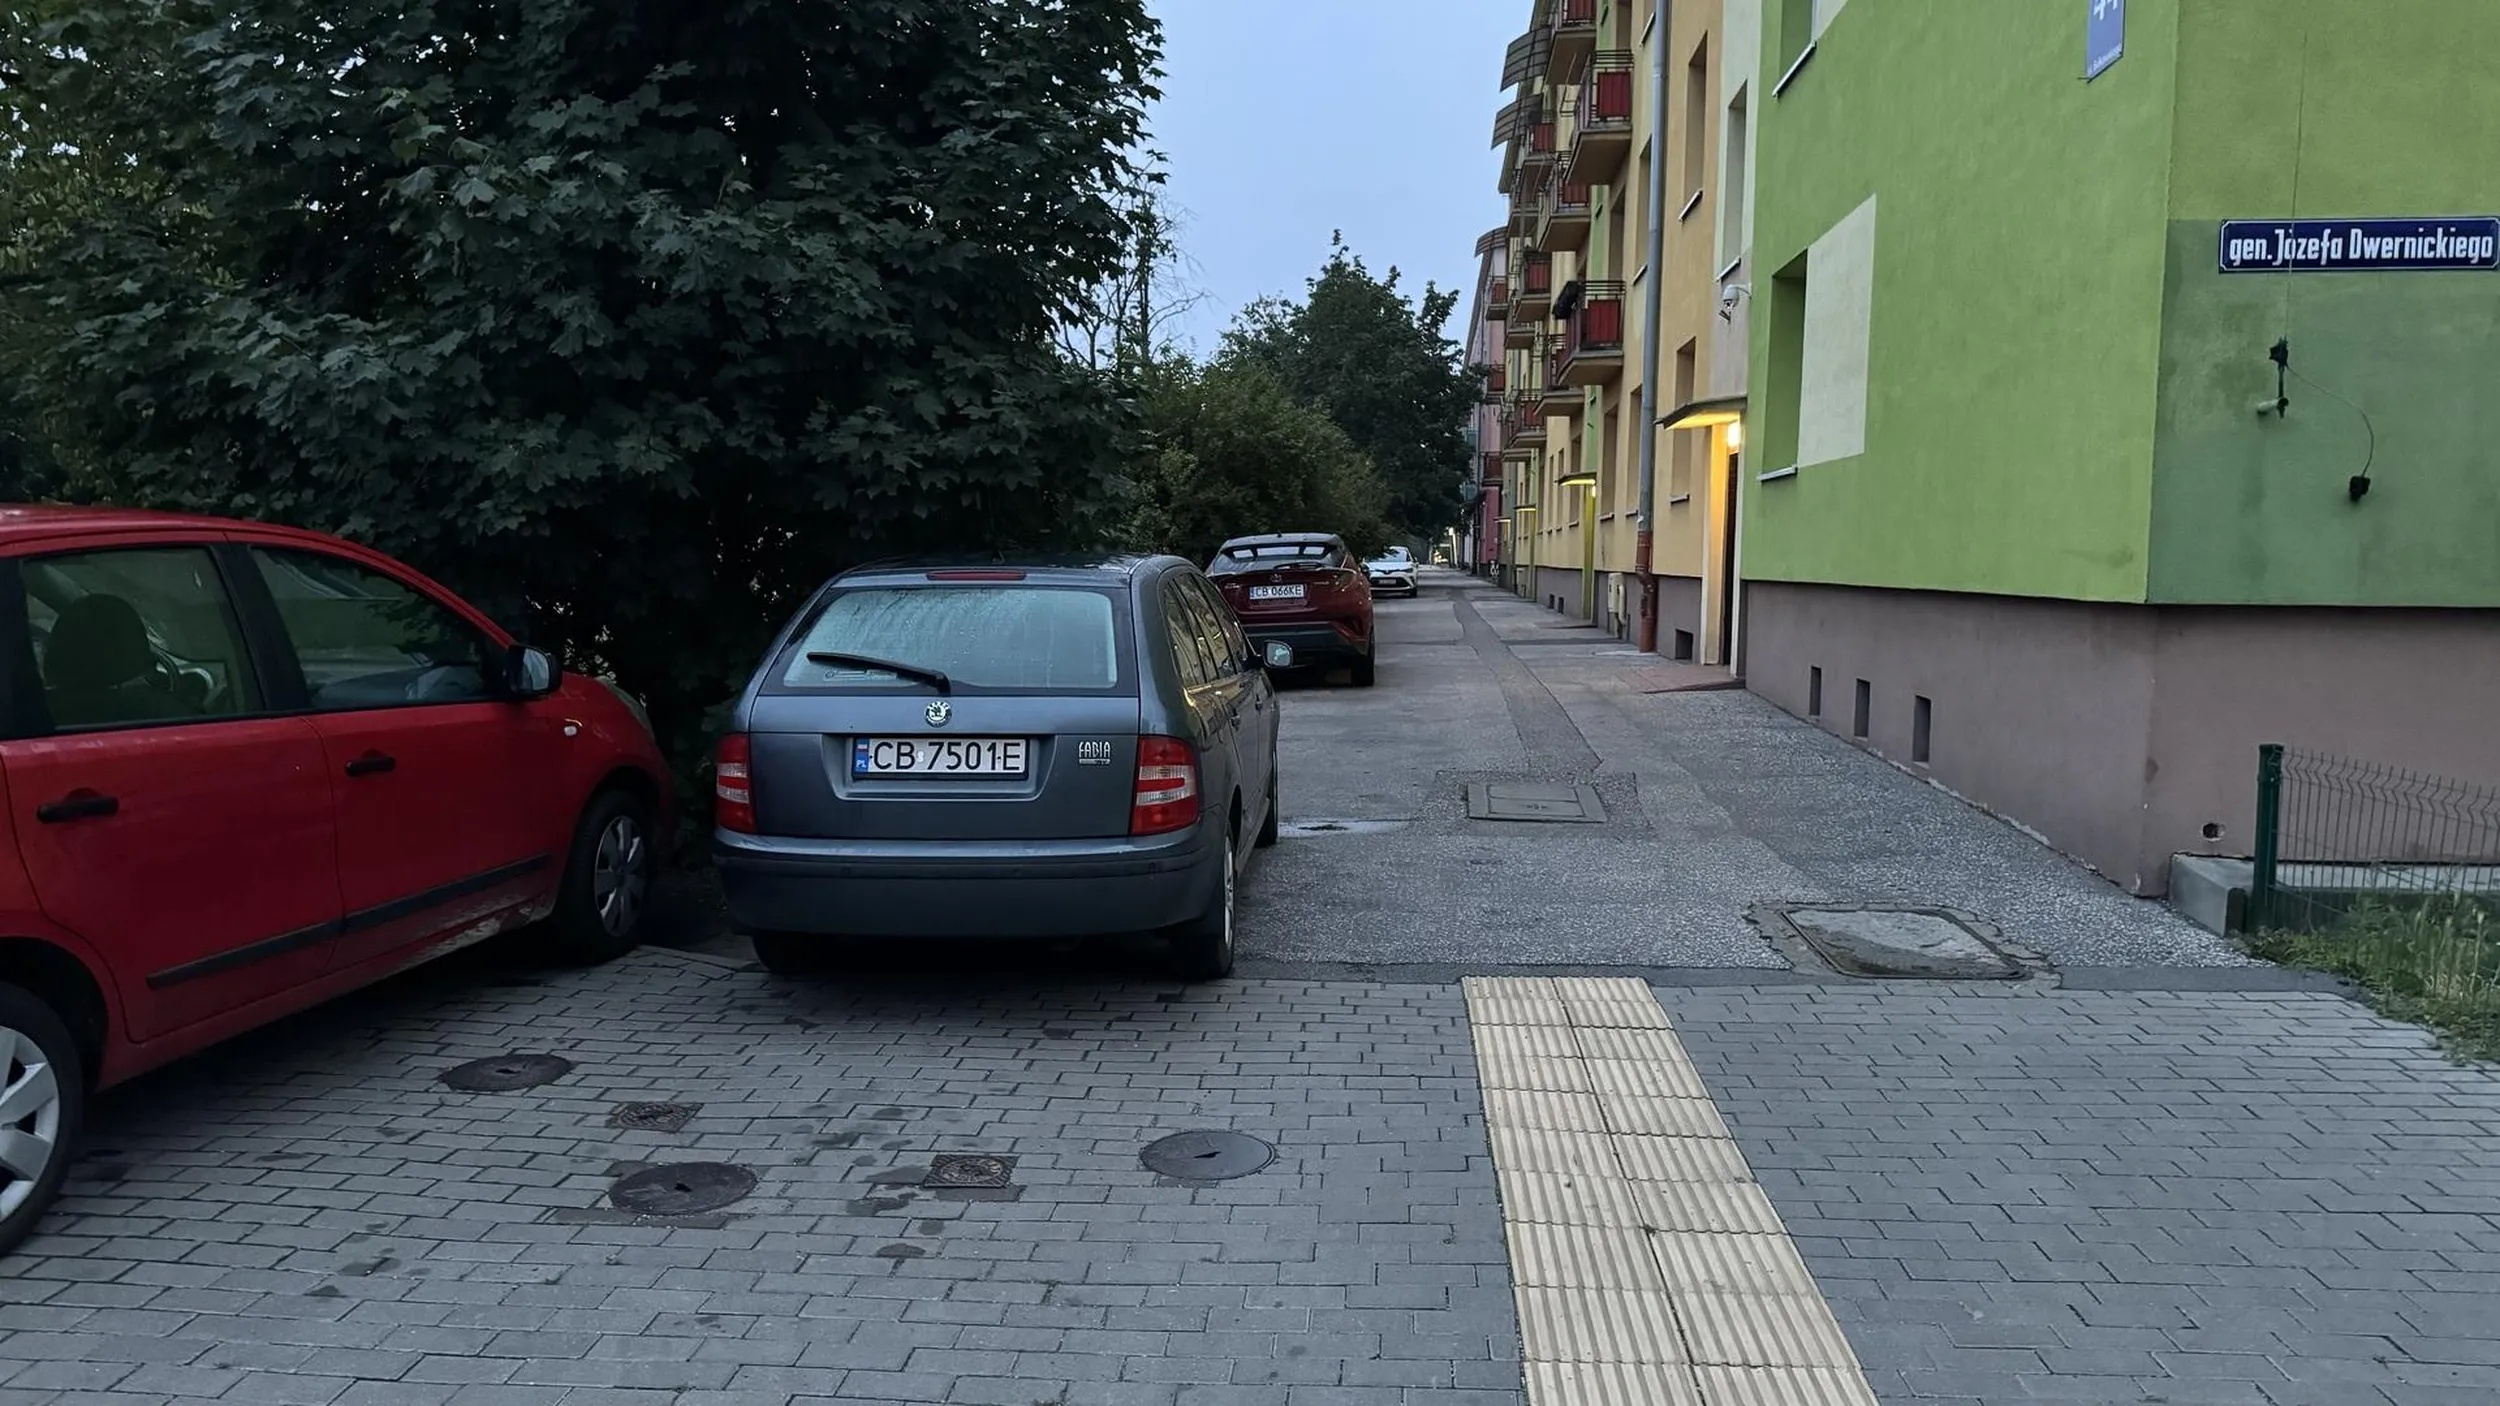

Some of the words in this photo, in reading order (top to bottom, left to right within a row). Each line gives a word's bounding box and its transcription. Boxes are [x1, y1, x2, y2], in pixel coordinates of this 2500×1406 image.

[2229, 238, 2273, 266] gen.
[2272, 228, 2343, 266] Józefa
[2349, 226, 2493, 264] Dwernickiego
[1256, 586, 1268, 597] CB
[1271, 585, 1302, 596] 066KE
[874, 741, 916, 770] CB
[927, 741, 1021, 771] 7501E
[1079, 741, 1111, 758] FABIA
